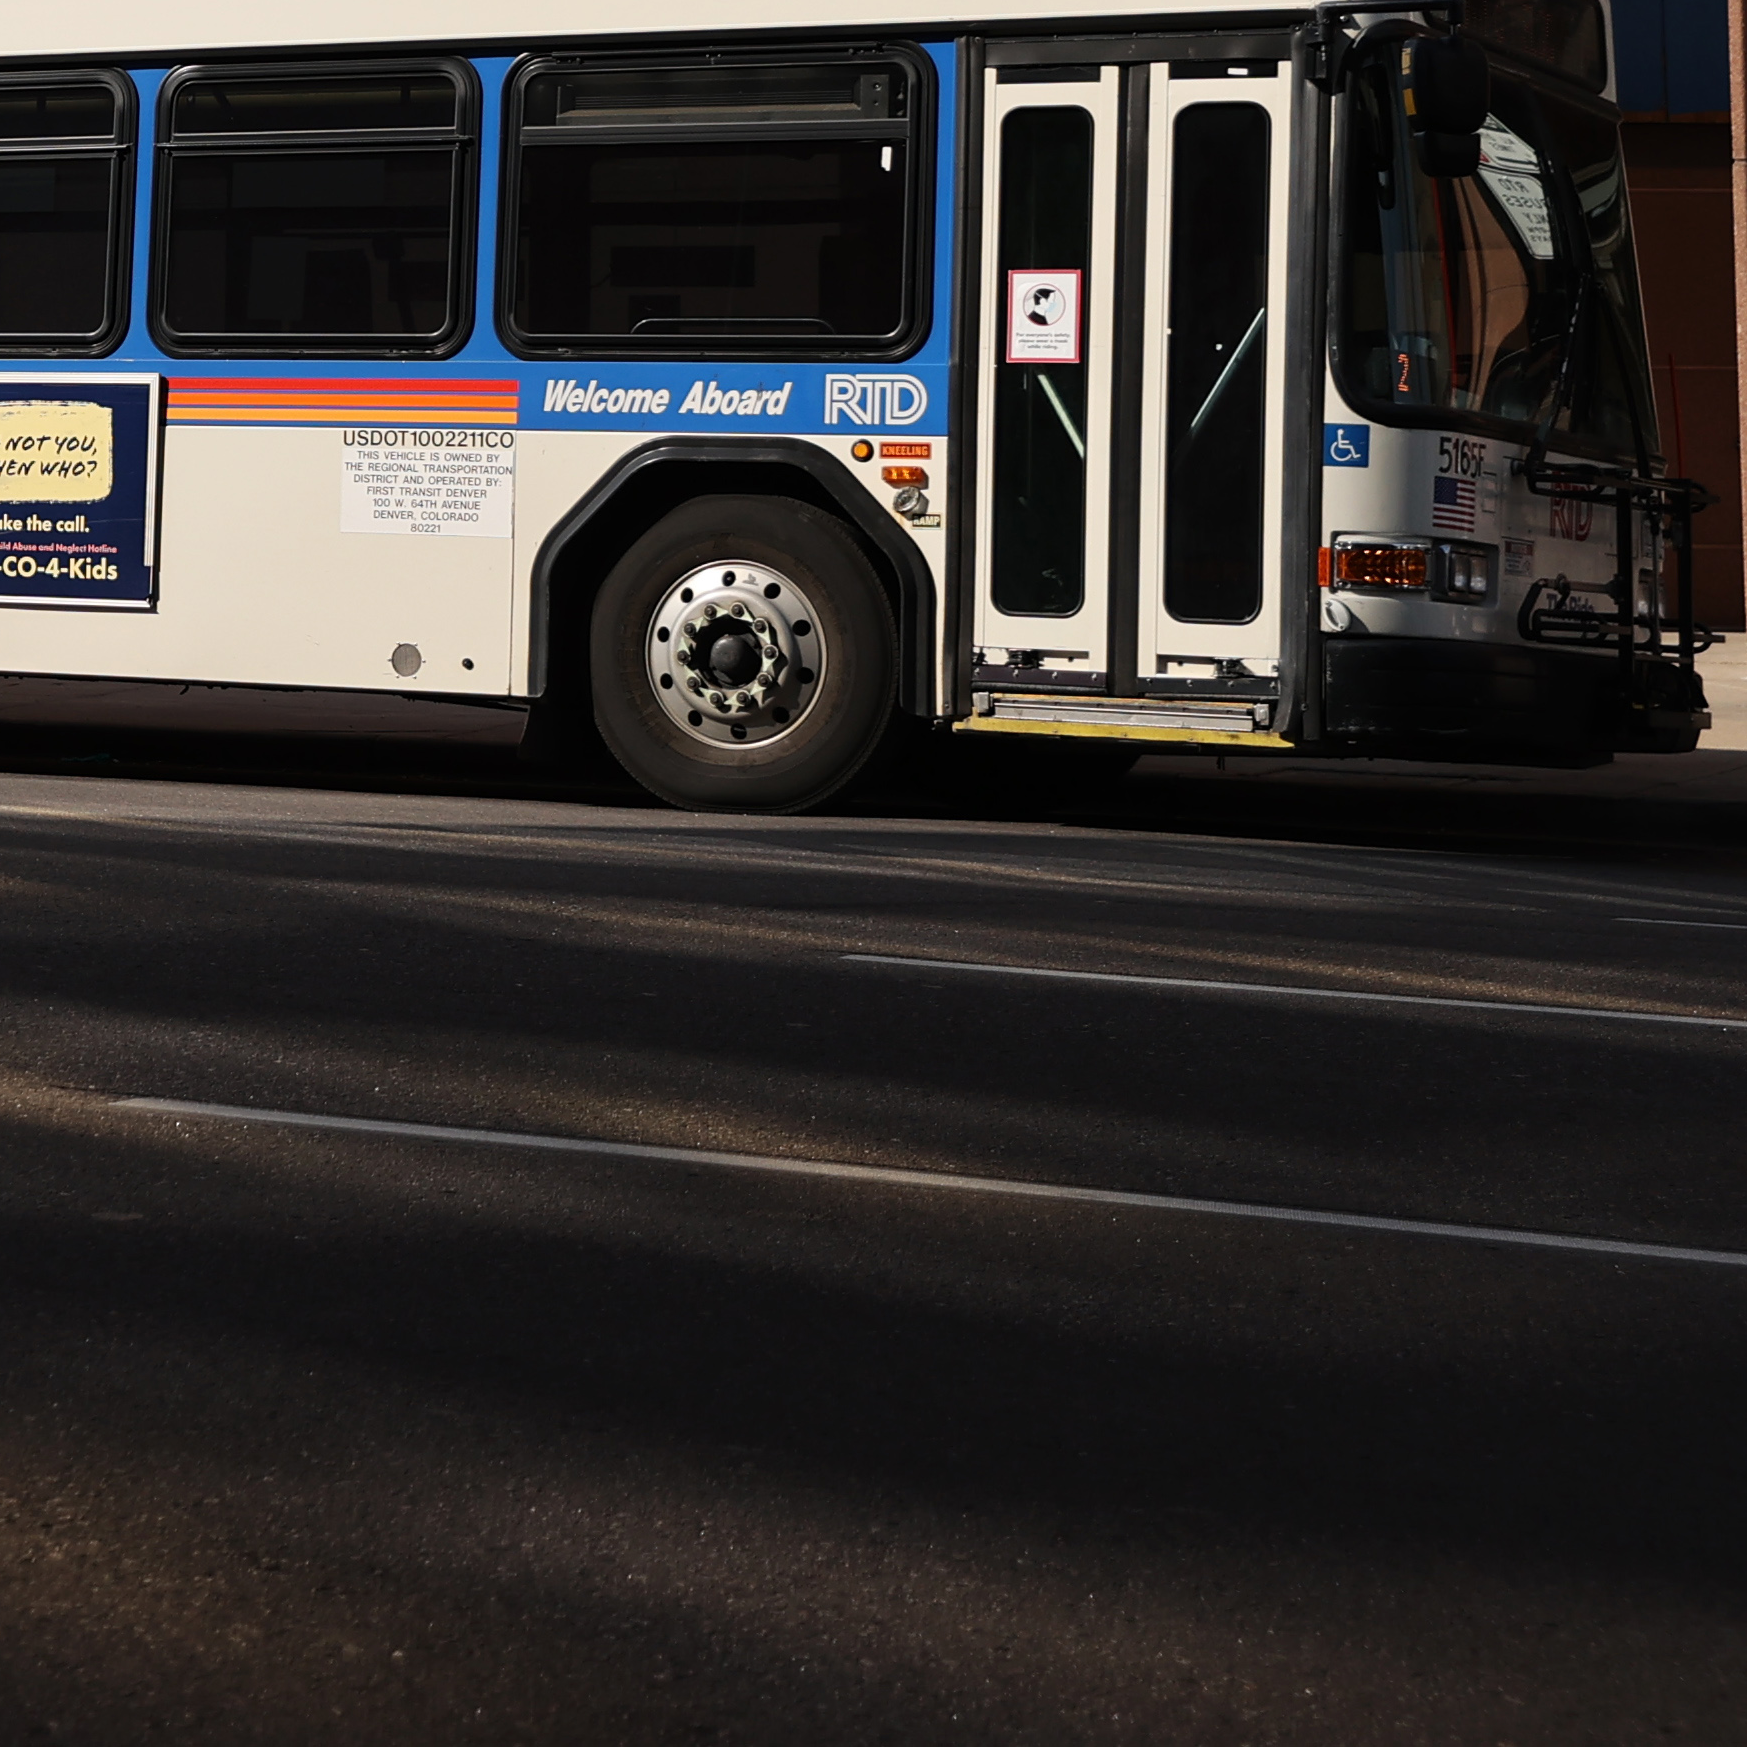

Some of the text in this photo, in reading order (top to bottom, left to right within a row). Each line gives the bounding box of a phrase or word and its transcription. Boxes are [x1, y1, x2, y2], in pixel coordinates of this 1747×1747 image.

[543, 379, 794, 416] Welcome Aboard
[824, 373, 928, 426] RTD
[4, 435, 51, 451] NOT
[55, 435, 97, 456] YOU,
[343, 430, 515, 448] USDOT1002211CO
[357, 450, 501, 463] THIS VEHICLE IS OWNED BY
[882, 445, 928, 456] KNEELING
[1438, 436, 1487, 479] 5165F
[40, 460, 98, 479] WHO?
[344, 462, 513, 475] THE REGIONAL TRANSPORTATION
[353, 474, 503, 487] DISTRICT AND OPERATED BY:
[366, 486, 488, 498] FIRST TRANSIT DENVER
[372, 498, 481, 510] 100 W. 64TH AVENUE
[373, 510, 480, 522] DENVER, COLORADO
[913, 515, 940, 526] RAMP
[26, 514, 53, 532] the
[55, 515, 90, 533] call.
[410, 523, 441, 533] 80221
[12, 542, 38, 551] Abuse
[38, 542, 55, 552] and
[55, 543, 87, 554] Neglect
[87, 544, 118, 553] Hotline
